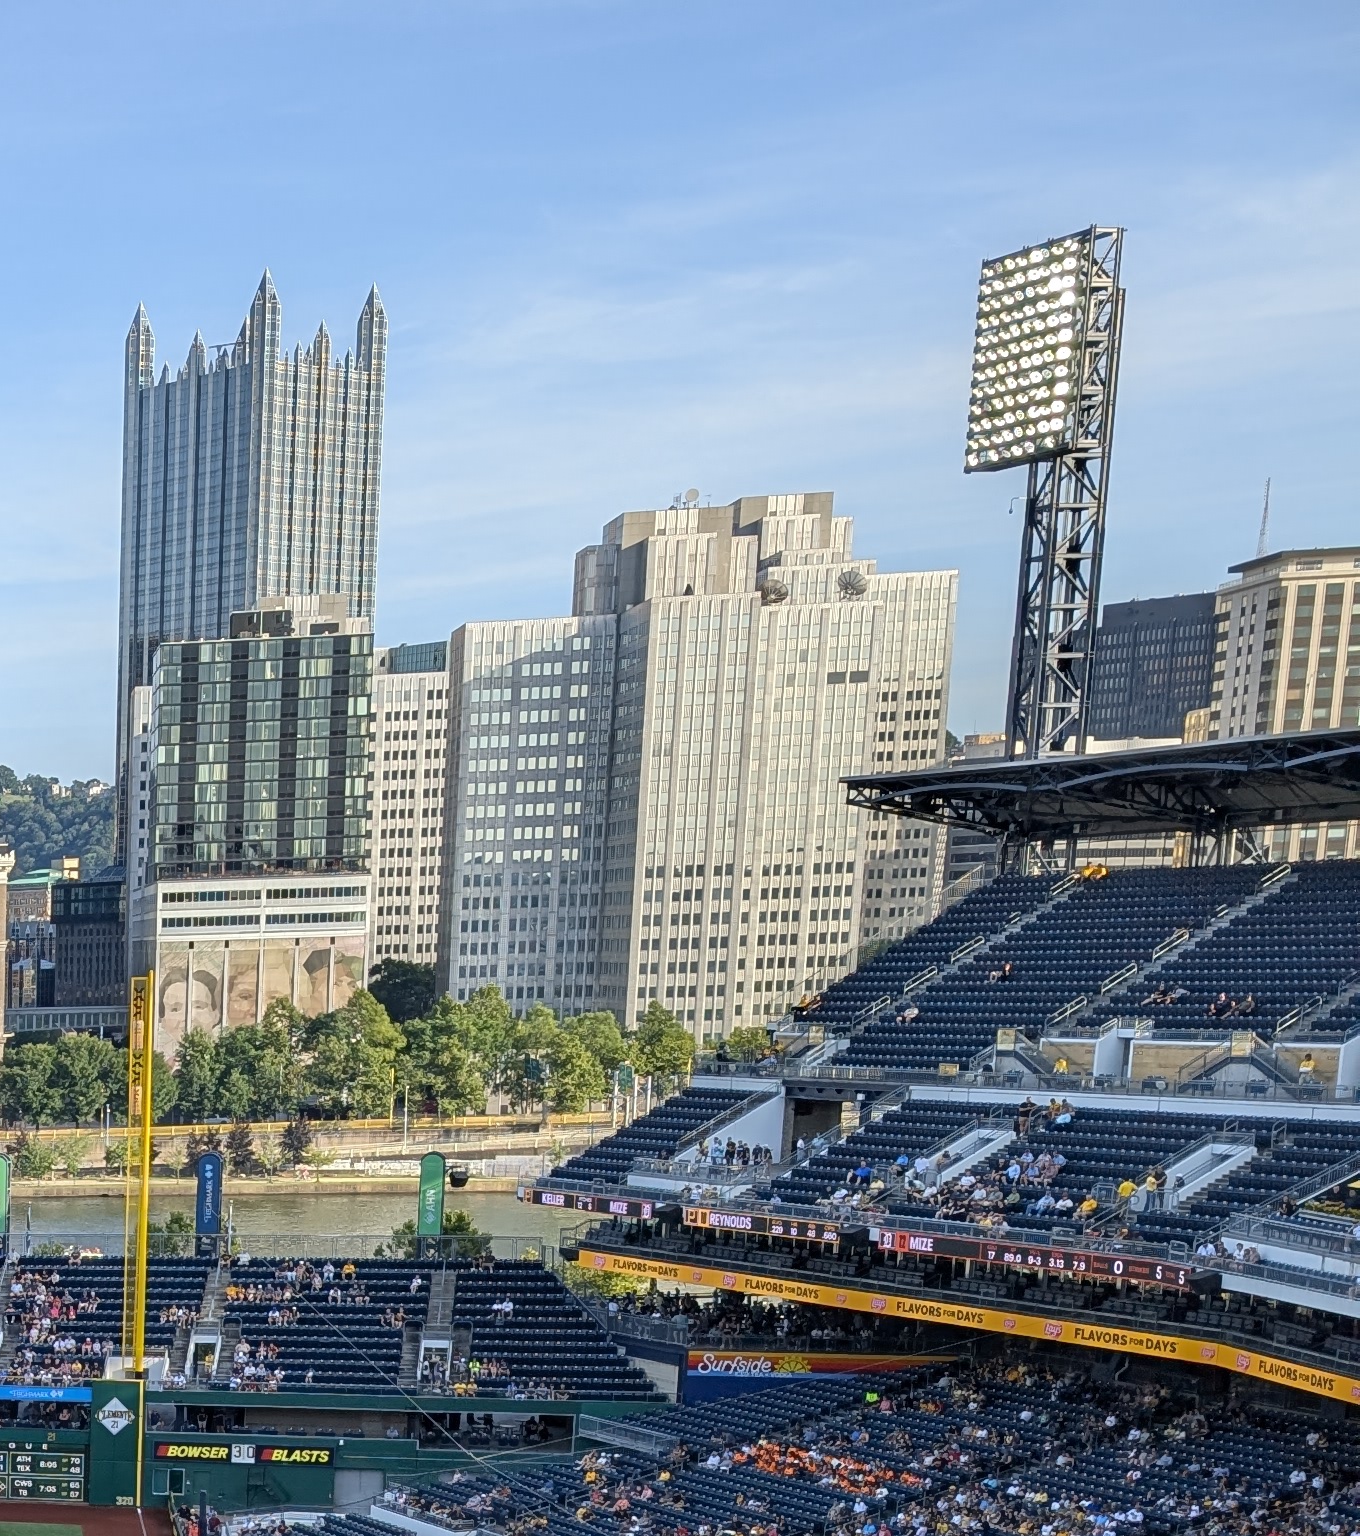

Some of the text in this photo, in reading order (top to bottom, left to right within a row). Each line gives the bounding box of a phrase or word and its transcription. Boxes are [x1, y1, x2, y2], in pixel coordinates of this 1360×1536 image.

[427, 1189, 436, 1211] AHN
[541, 1193, 565, 1206] KELLER
[609, 1201, 628, 1214] MIZE
[709, 1213, 752, 1230] REYNOLDS
[909, 1236, 933, 1251] MIZE
[613, 1258, 647, 1273] FLAVORS
[658, 1266, 679, 1277] DAYS
[988, 1251, 996, 1259] 17
[1004, 1254, 1021, 1263] 89.0
[1049, 1258, 1064, 1268] 3.13
[1072, 1262, 1085, 1271] 7.9
[1114, 1261, 1124, 1274] 0
[1155, 1266, 1162, 1279] 5
[1178, 1271, 1185, 1284] 5
[744, 1278, 784, 1294] FLAVORS
[796, 1287, 820, 1299] DAYS
[896, 1301, 942, 1318] FLAVORS
[956, 1310, 984, 1324] DAYS
[1074, 1328, 1177, 1353] FLAVORS FOR DAYS
[698, 1353, 772, 1374] Surfside
[1258, 1360, 1298, 1382] FLAVORS
[1310, 1374, 1335, 1391] DAYS
[111, 1420, 119, 1429] 21
[167, 1445, 329, 1463] BOWSER BLASTS
